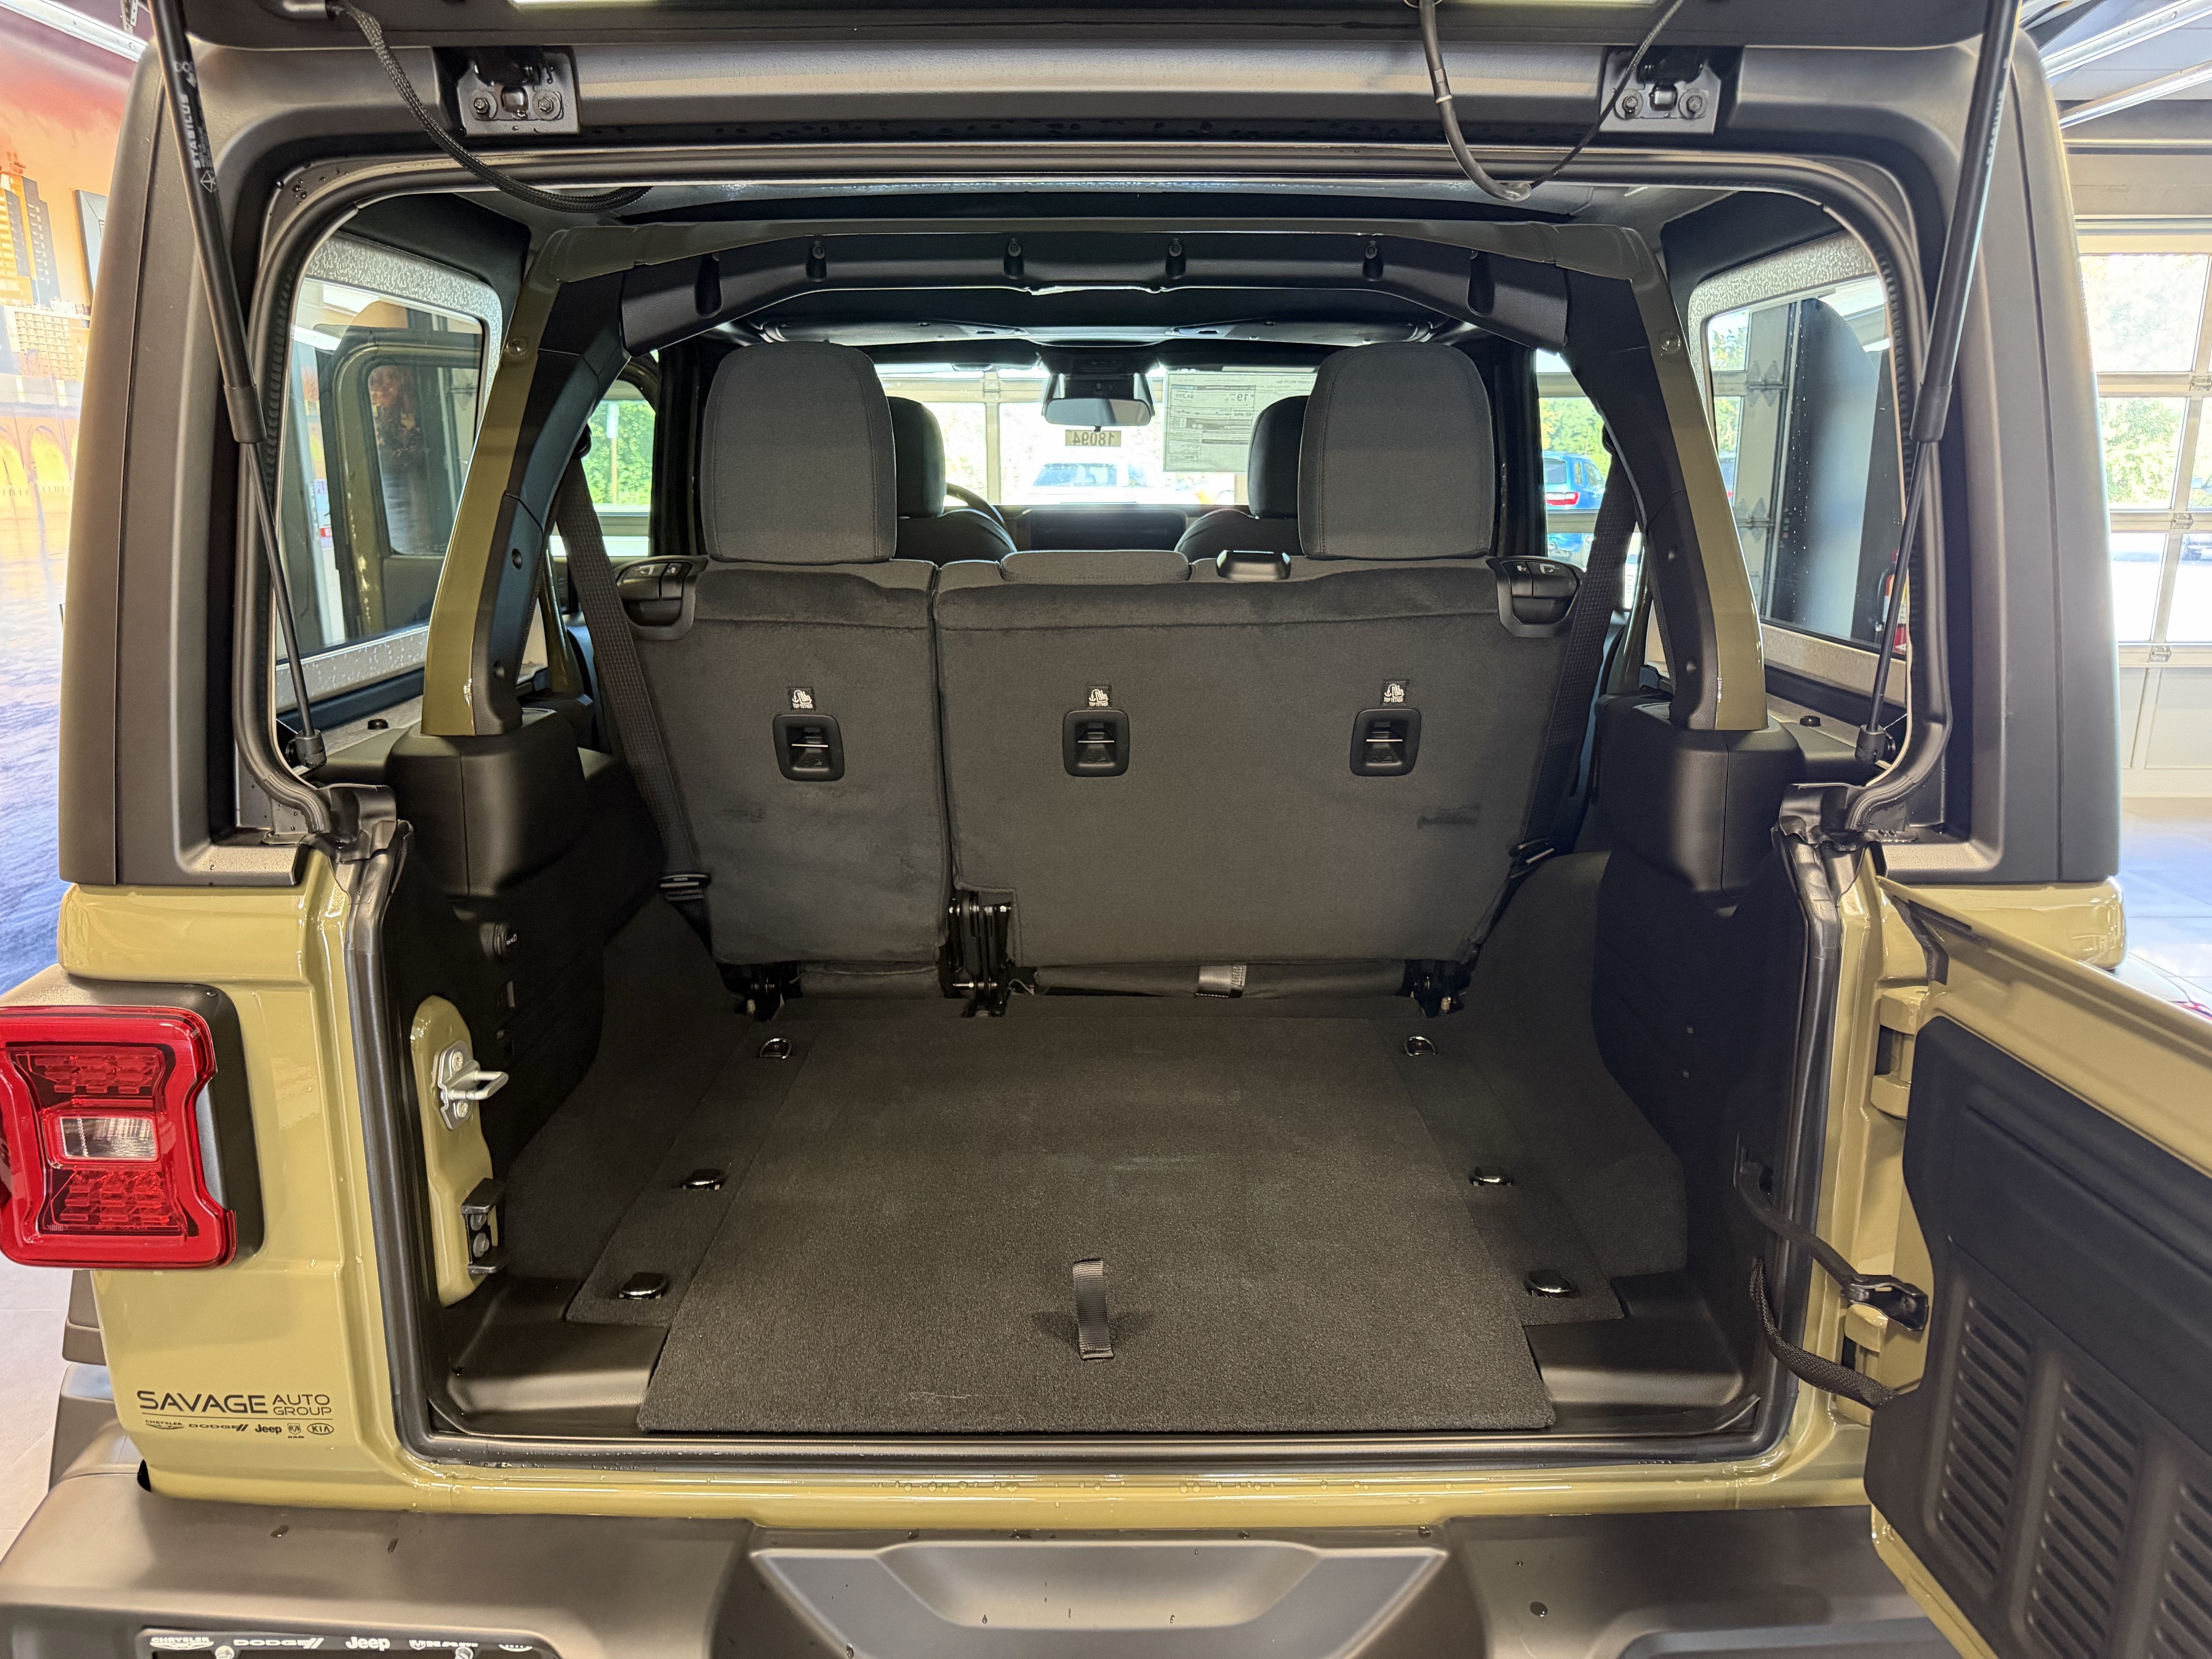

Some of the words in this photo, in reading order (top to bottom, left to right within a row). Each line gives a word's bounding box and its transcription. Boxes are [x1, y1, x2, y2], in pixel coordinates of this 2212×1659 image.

[180, 94, 201, 168] STABILUS
[137, 1390, 268, 1414] SAVAGE
[272, 1394, 330, 1405] AUTO
[273, 1407, 332, 1415] GROUP
[254, 1424, 282, 1434] Jeep
[345, 1636, 391, 1651] Jeep
